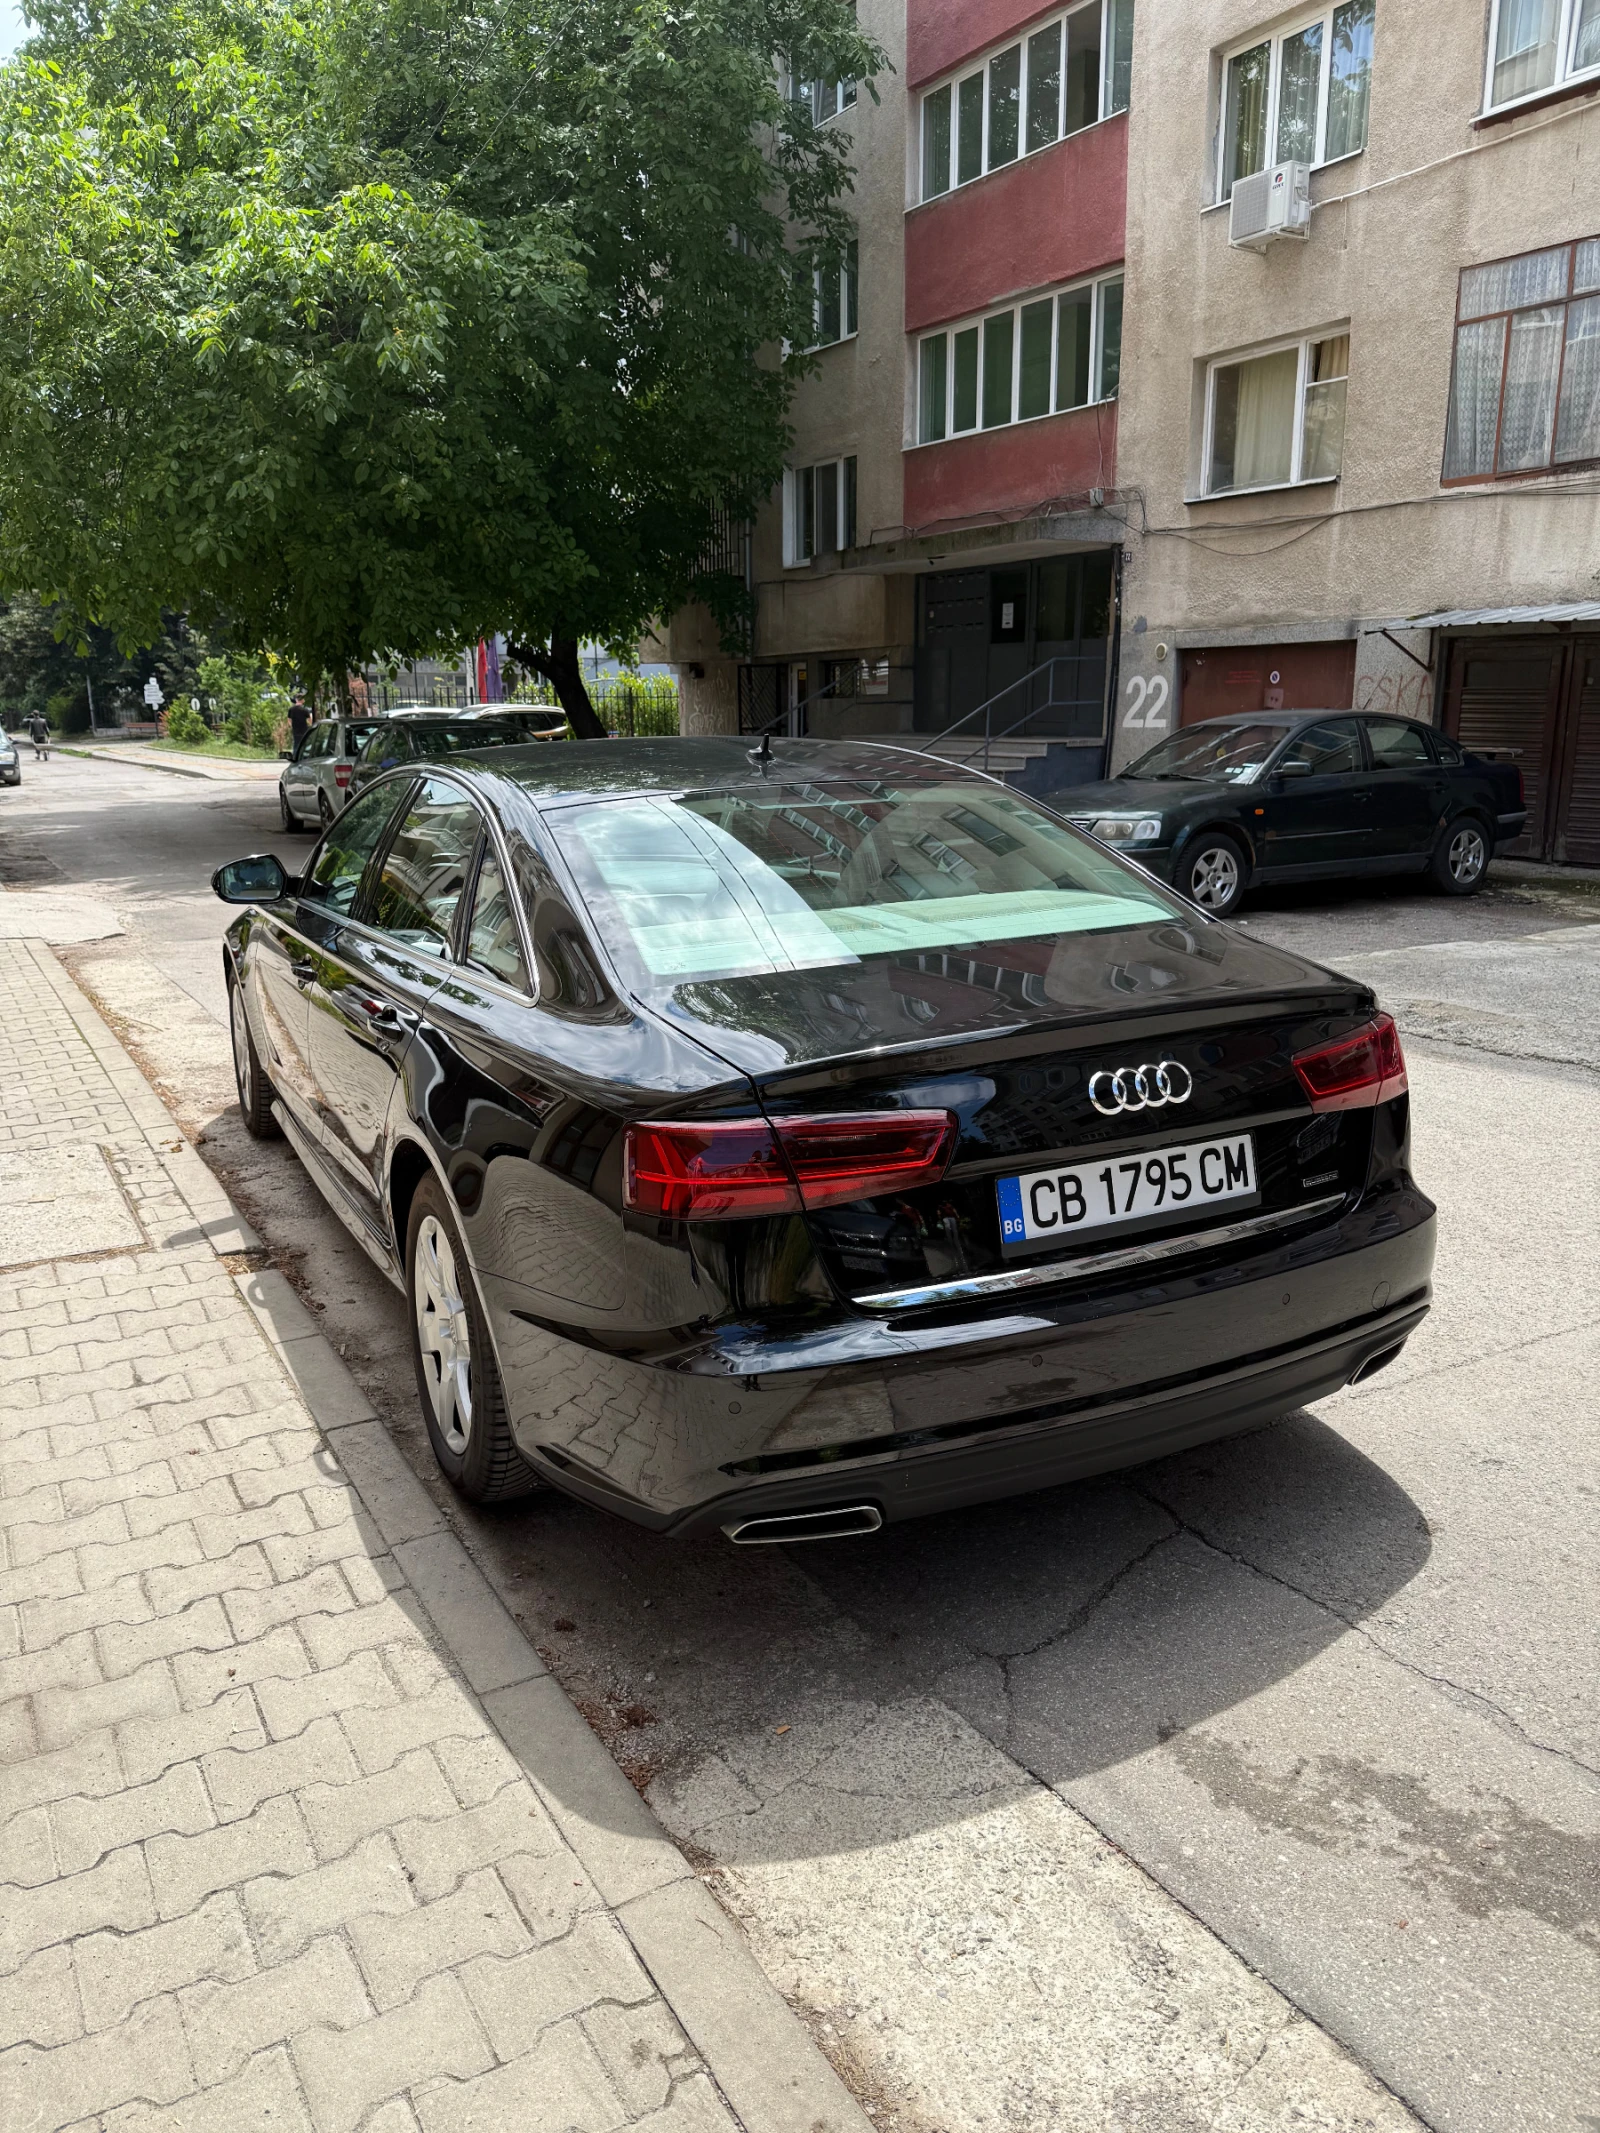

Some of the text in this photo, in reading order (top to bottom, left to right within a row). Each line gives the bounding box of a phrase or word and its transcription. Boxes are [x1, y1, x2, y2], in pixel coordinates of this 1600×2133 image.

[1122, 675, 1168, 727] 22
[1030, 1143, 1249, 1228] CB 1795 CM
[1003, 1218, 1023, 1235] BG
